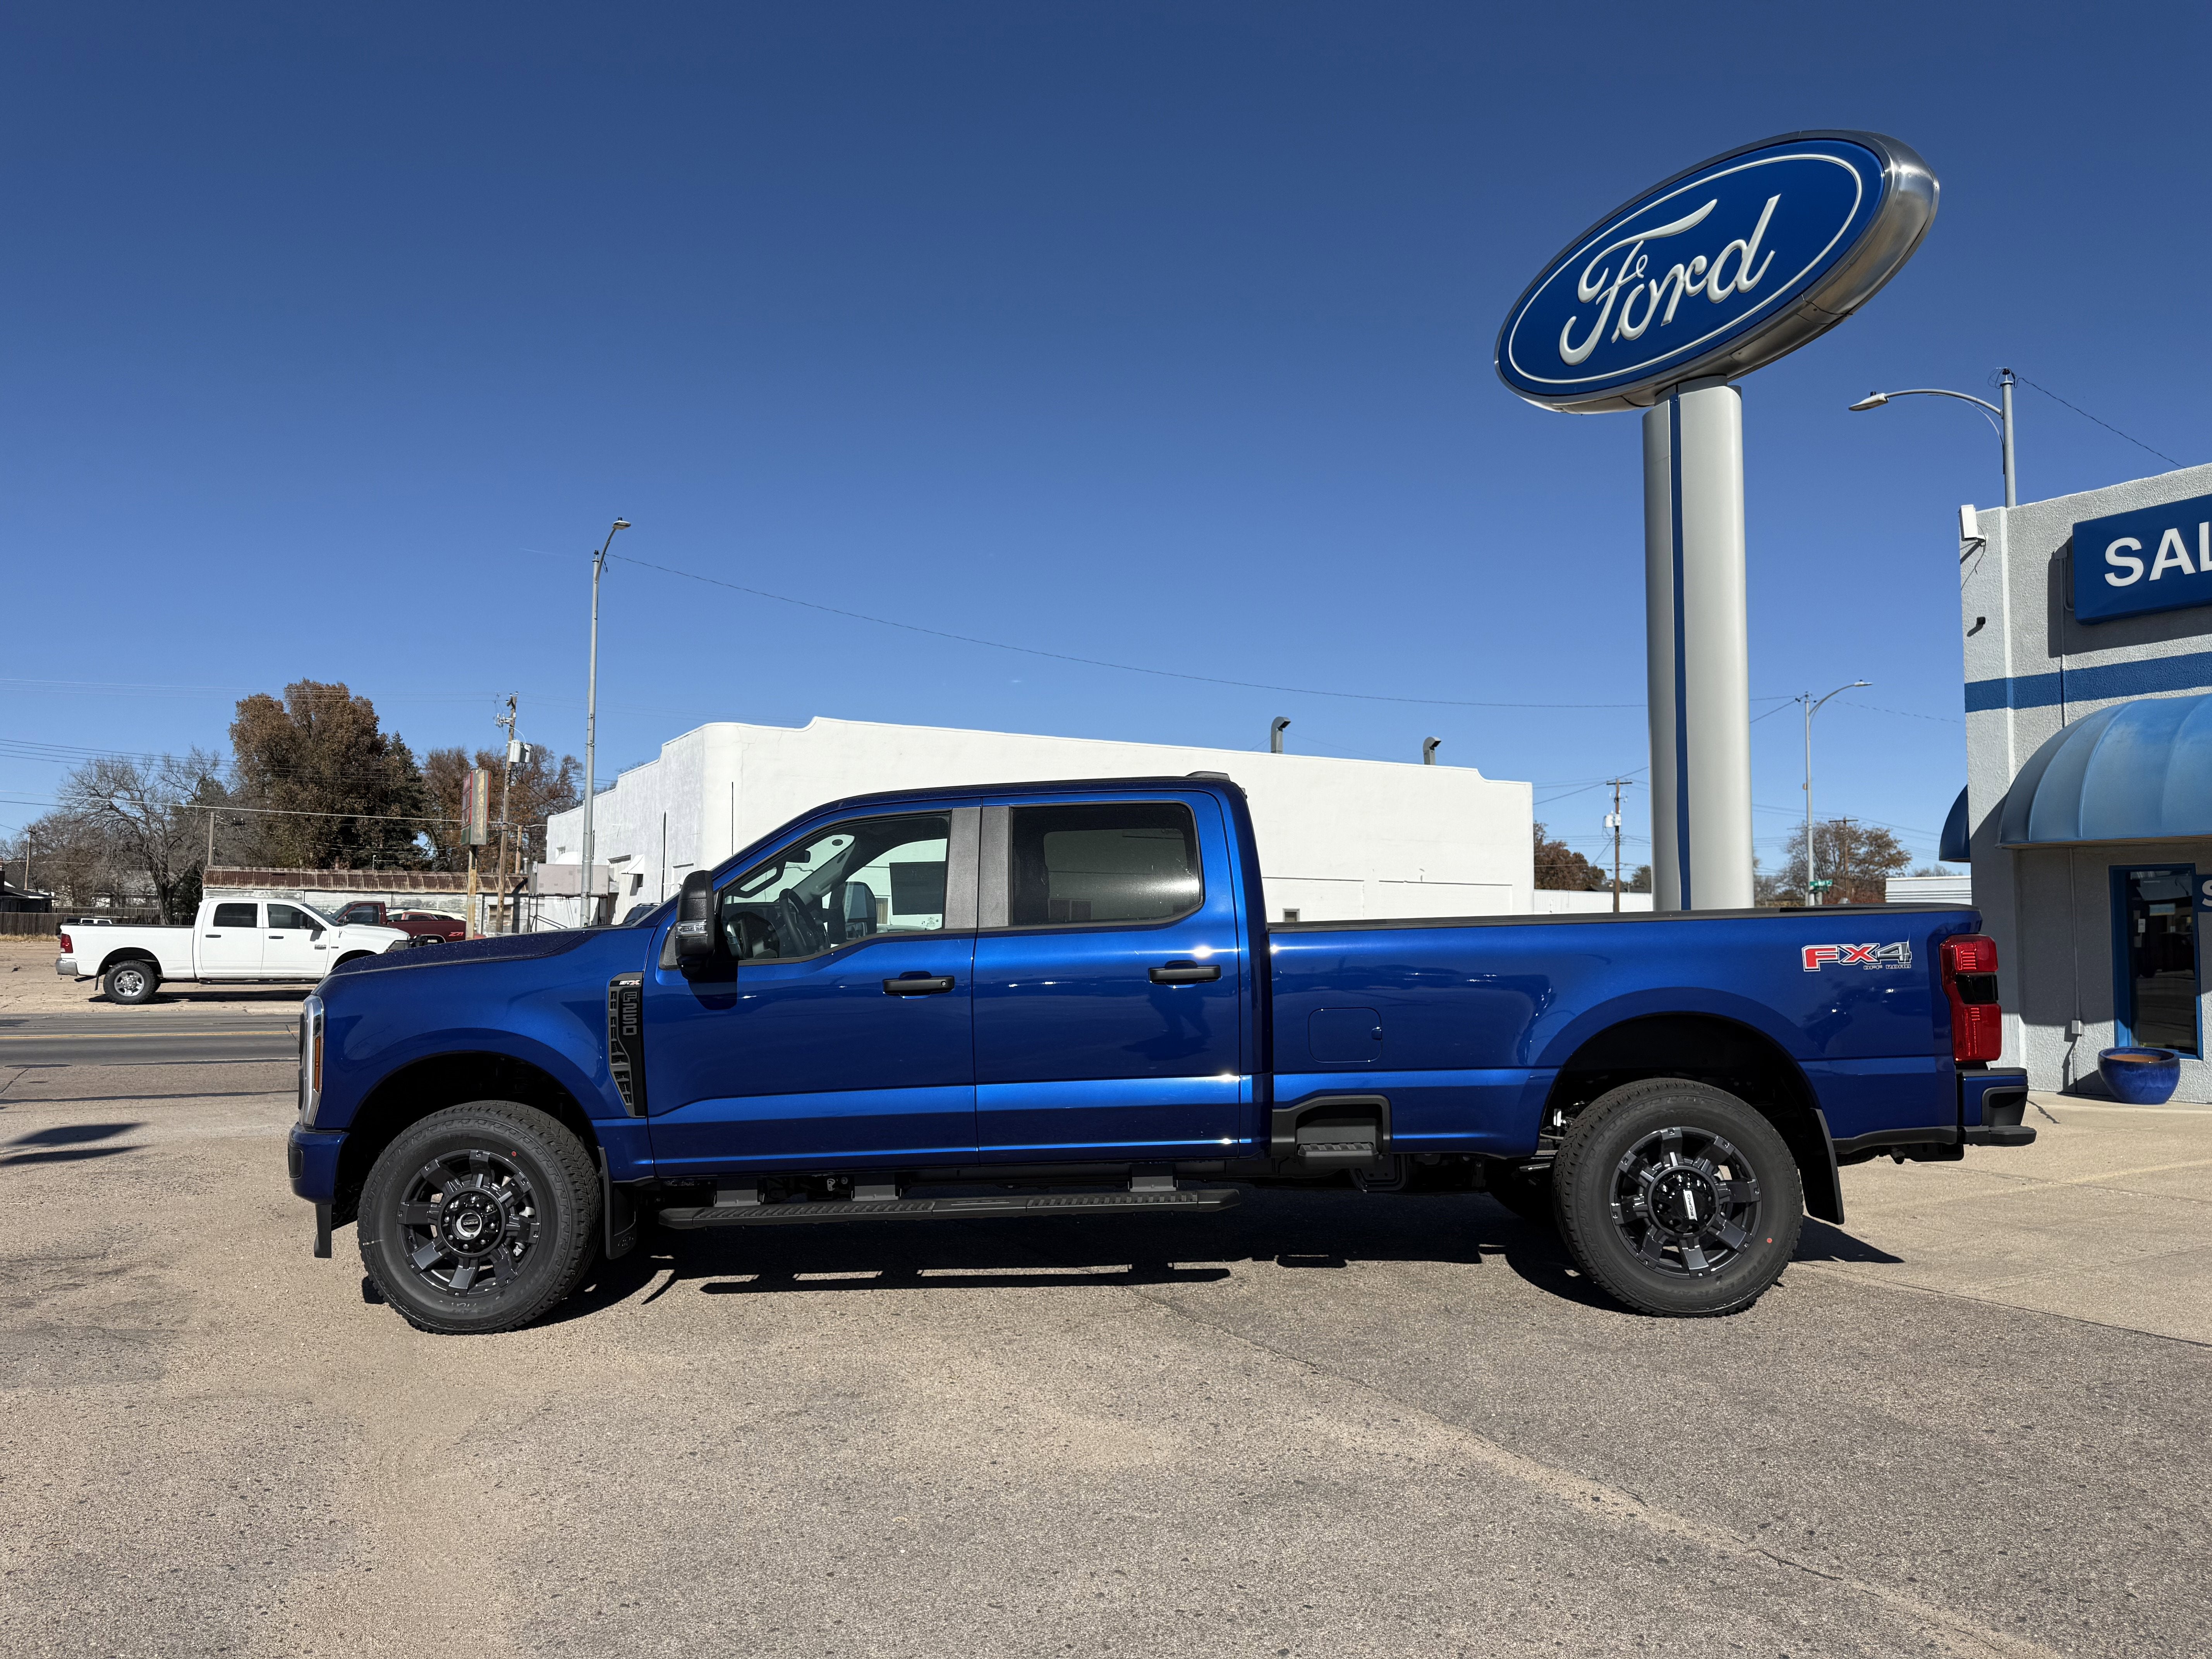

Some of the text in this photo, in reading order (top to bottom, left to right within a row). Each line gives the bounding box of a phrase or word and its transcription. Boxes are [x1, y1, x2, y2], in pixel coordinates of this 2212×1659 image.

[1559, 193, 1781, 366] Ford
[2104, 521, 2212, 587] SAL
[1802, 942, 1912, 972] FX4
